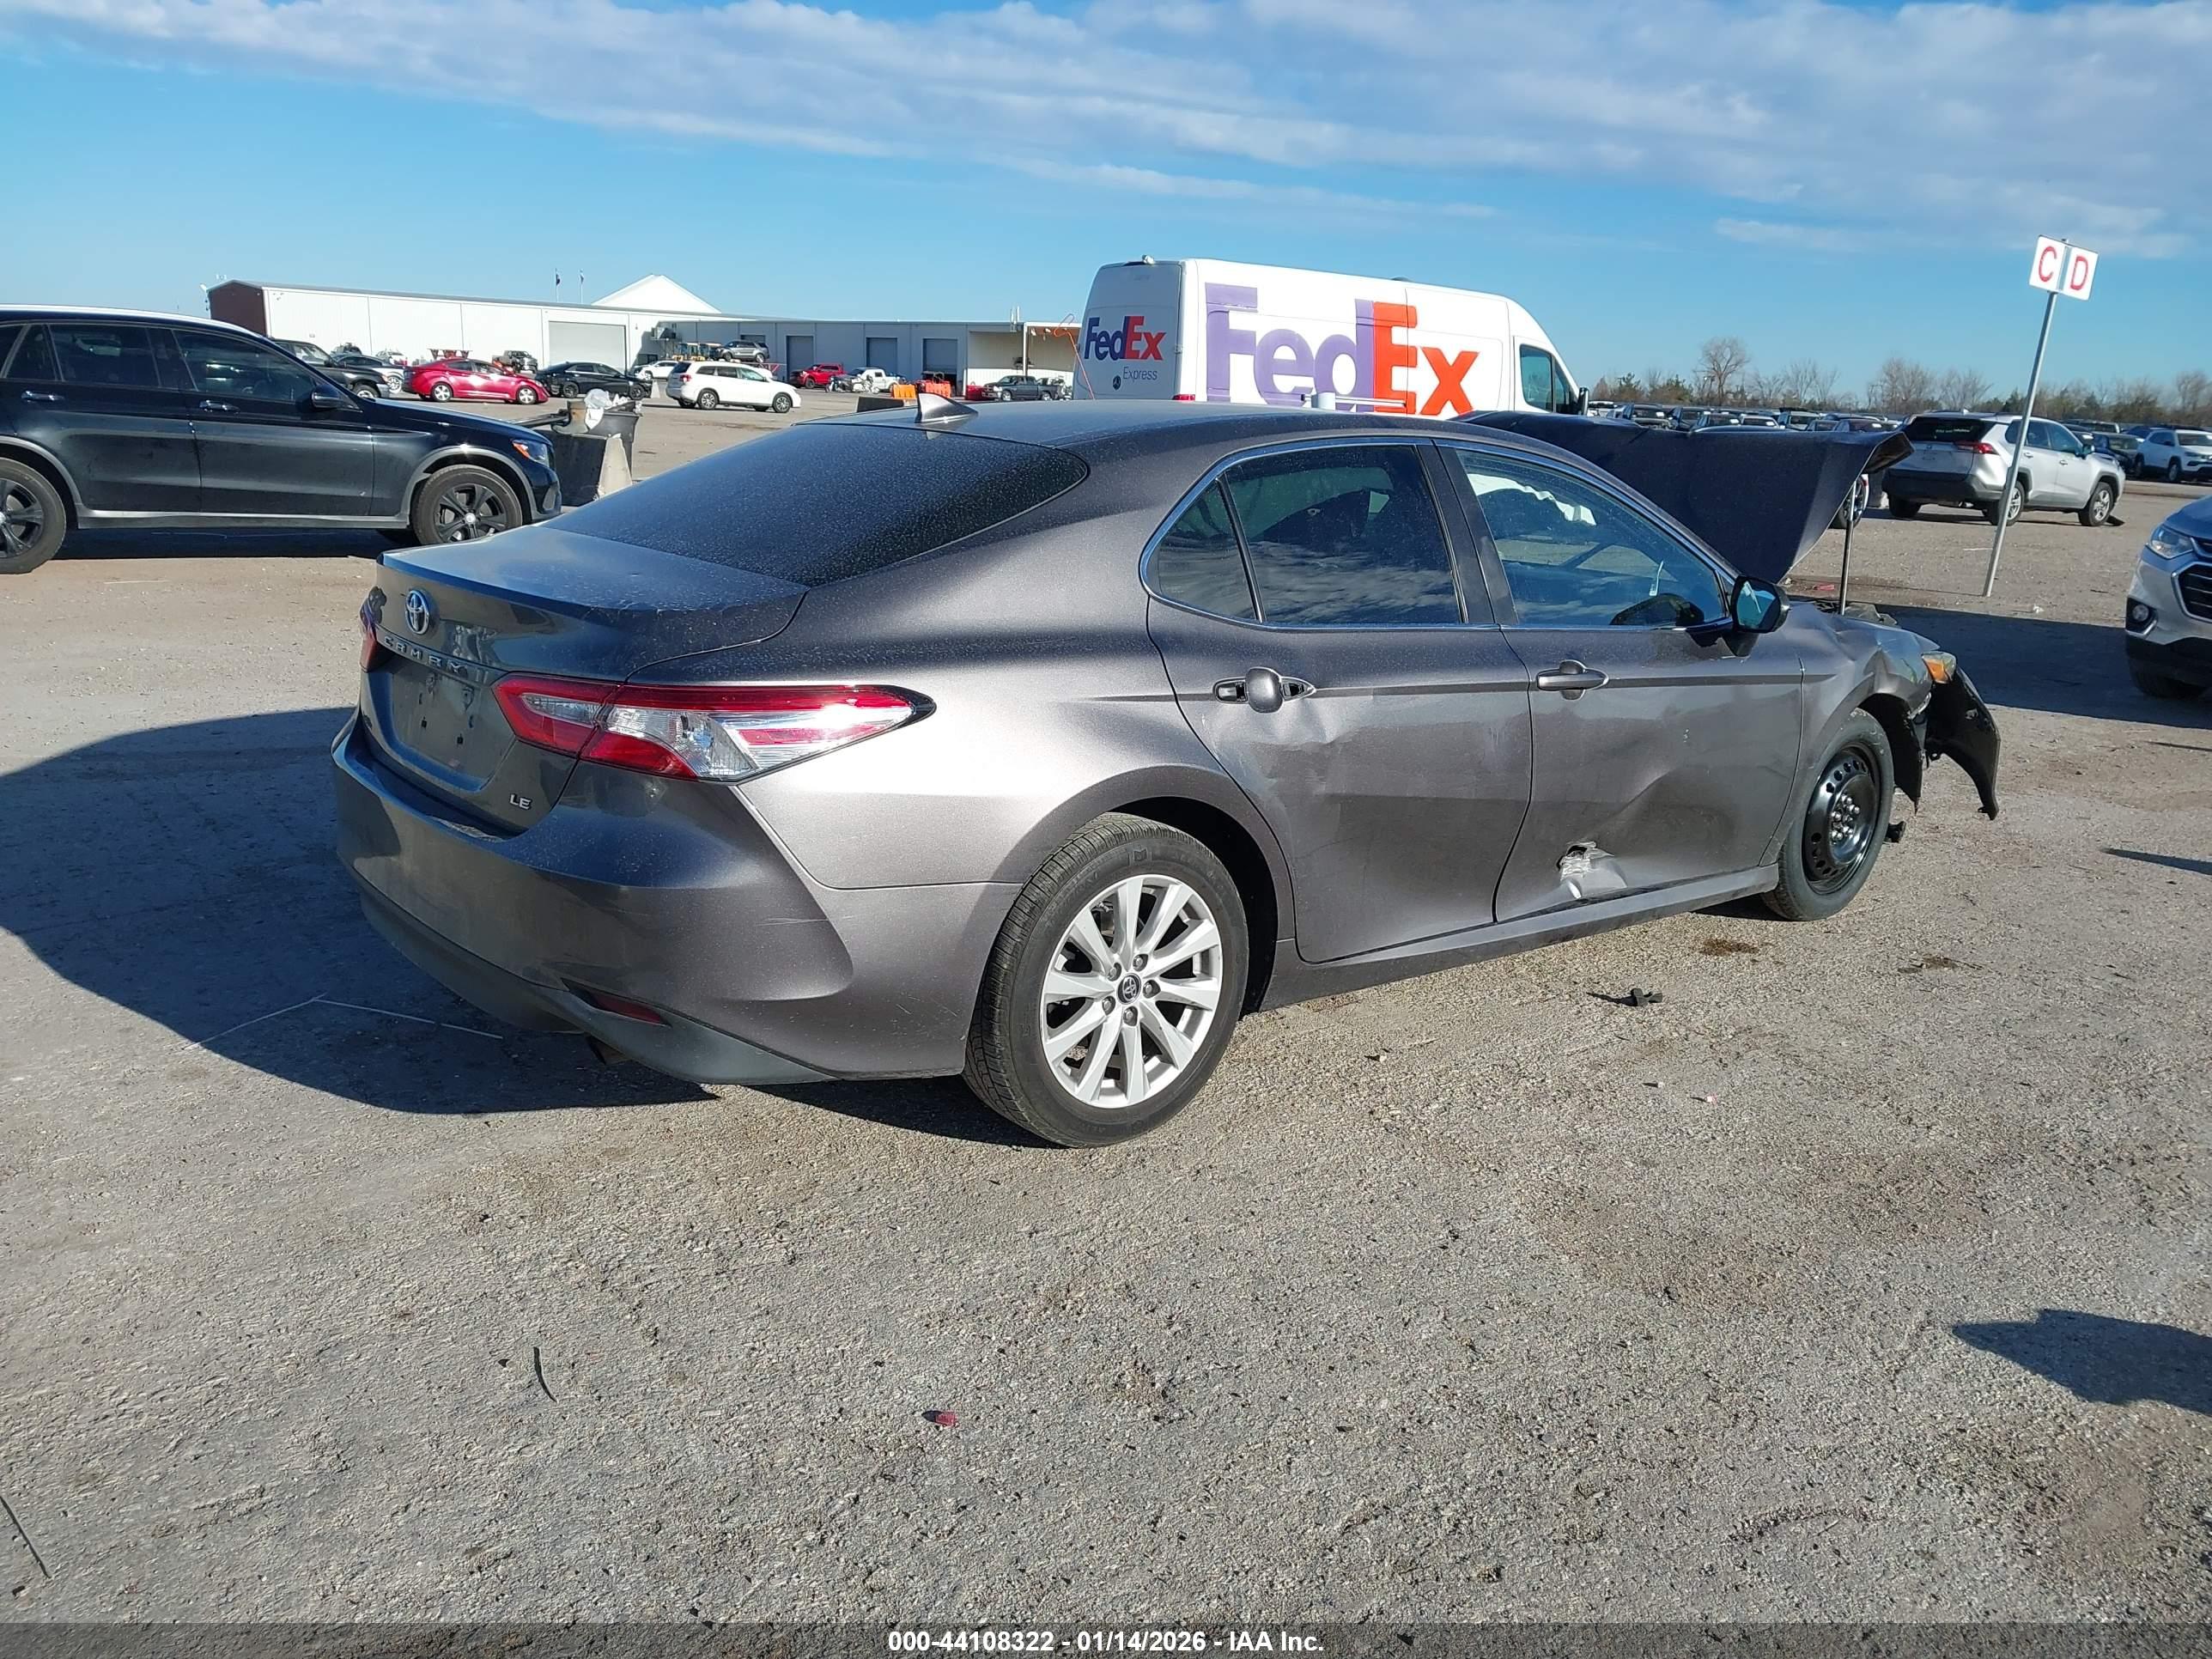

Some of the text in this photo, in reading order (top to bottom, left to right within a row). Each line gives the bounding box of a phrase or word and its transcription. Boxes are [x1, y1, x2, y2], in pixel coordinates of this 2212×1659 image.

[2039, 246, 2057, 282] C
[2070, 255, 2088, 290] D
[1084, 315, 1166, 361] FedEx
[1205, 282, 1480, 416] FedEx
[1122, 366, 1158, 382] Express
[384, 635, 468, 674] CAMRY
[509, 793, 532, 810] LE
